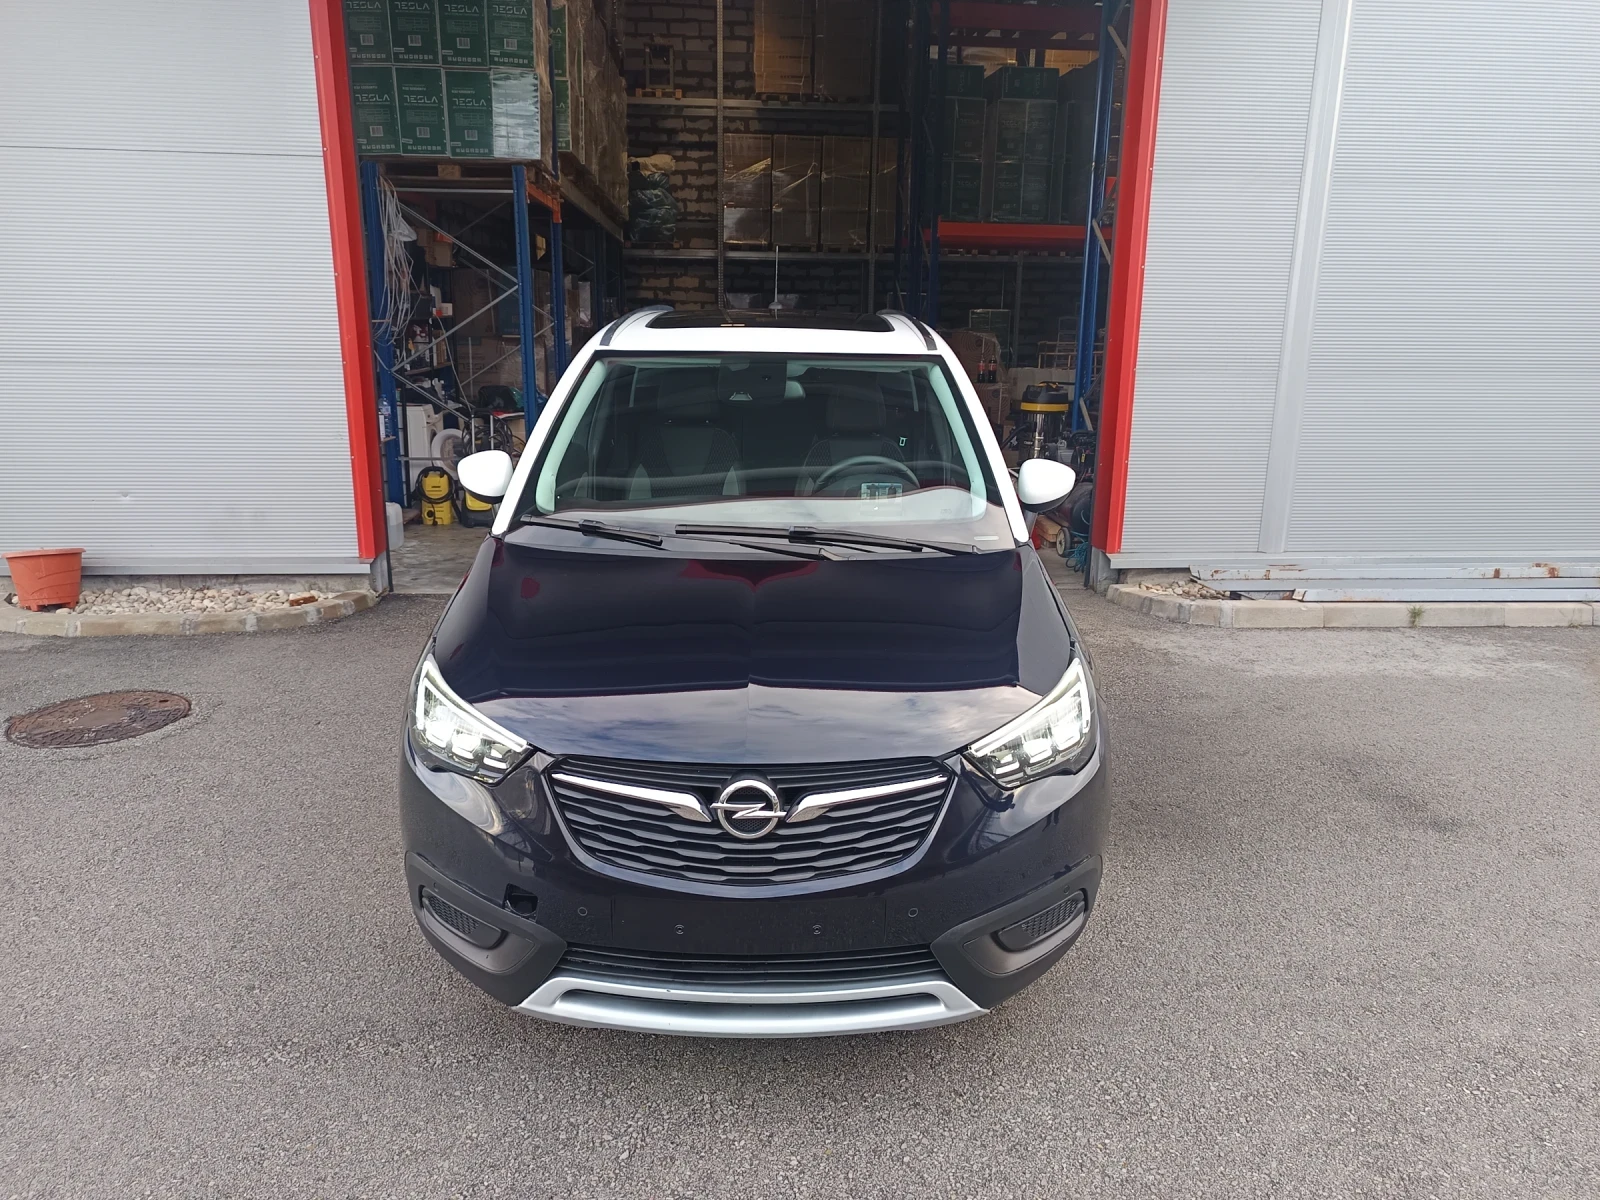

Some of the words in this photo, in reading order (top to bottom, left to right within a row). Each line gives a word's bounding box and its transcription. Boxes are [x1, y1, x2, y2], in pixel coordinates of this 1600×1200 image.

[346, 1, 382, 9] TESLA
[394, 2, 430, 10] TESLA
[444, 4, 479, 13] TESLA
[492, 5, 528, 15] TESLA
[355, 93, 390, 102] TESLA
[403, 95, 439, 104] TESLA
[452, 98, 487, 106] TESLA
